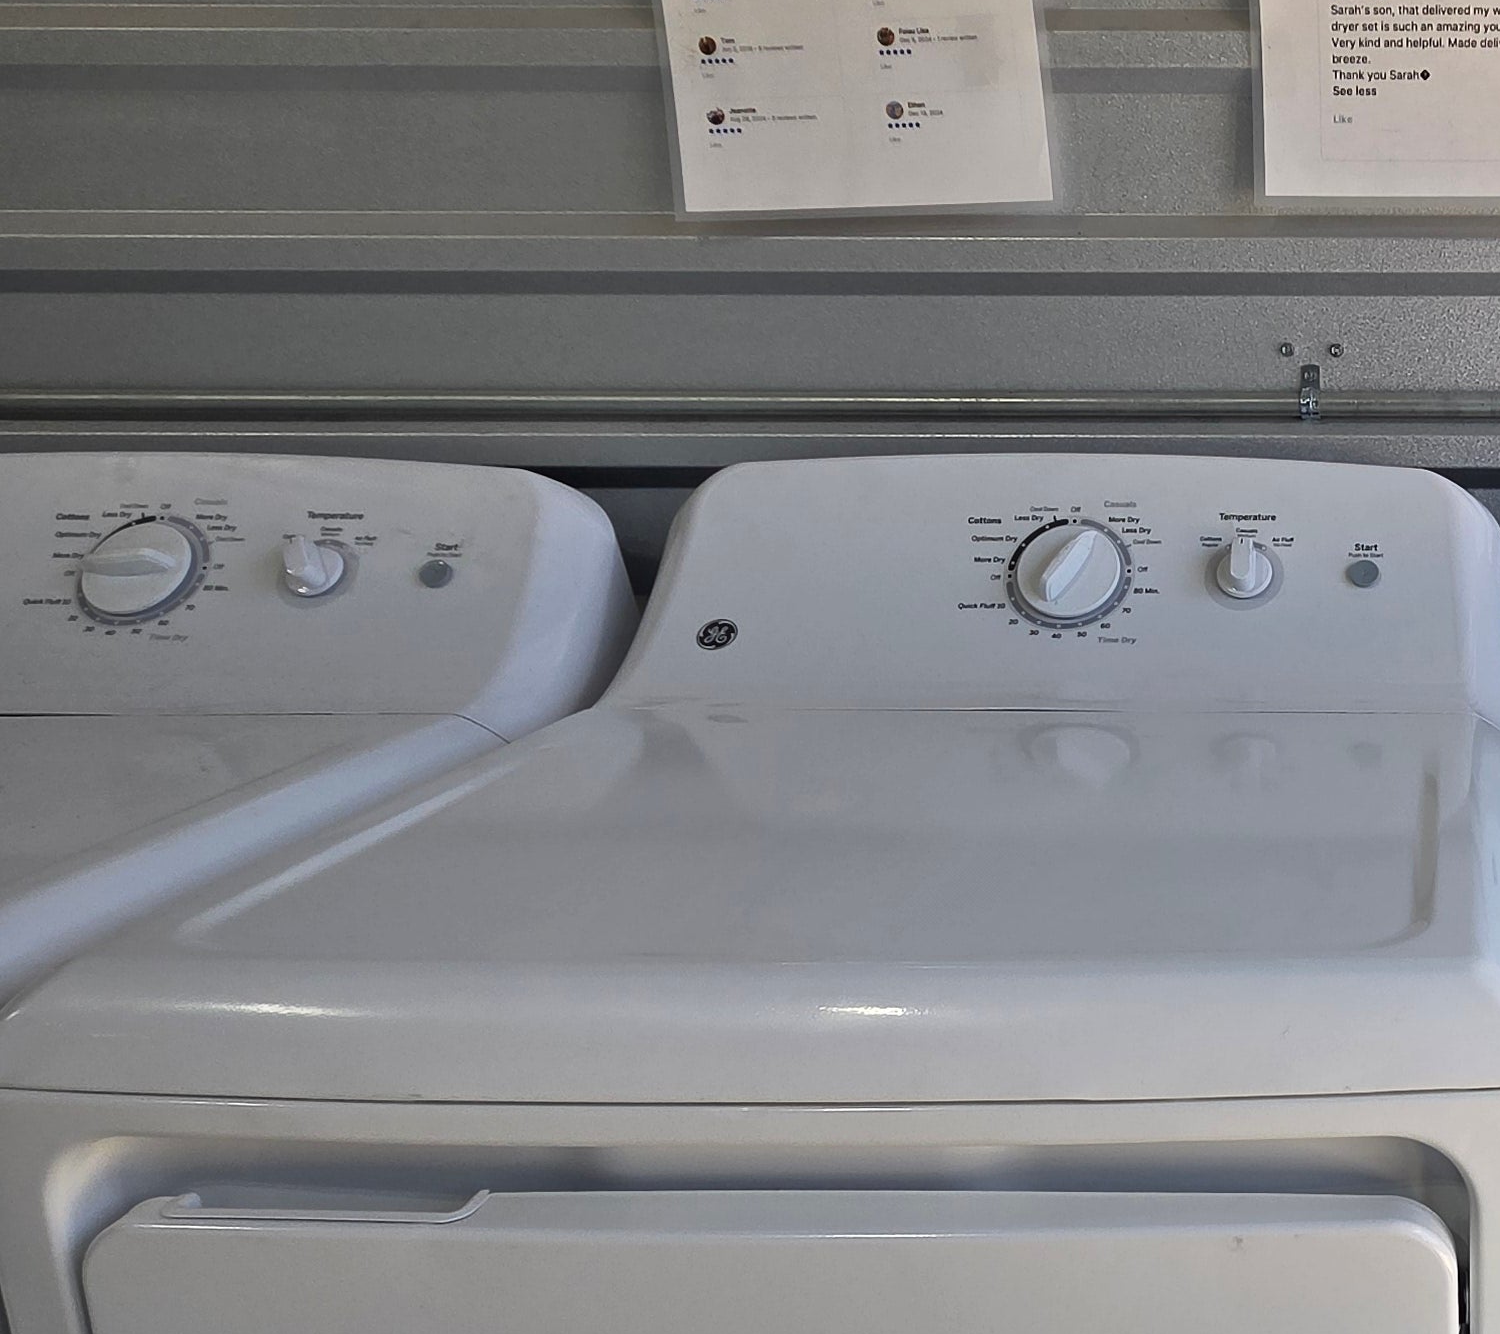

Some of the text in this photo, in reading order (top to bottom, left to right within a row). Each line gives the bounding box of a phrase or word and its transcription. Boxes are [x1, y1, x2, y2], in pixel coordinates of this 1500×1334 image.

[1373, 7, 1394, 17] son,
[1399, 5, 1418, 15] that
[1422, 5, 1470, 15] delivered
[1474, 7, 1489, 17] my
